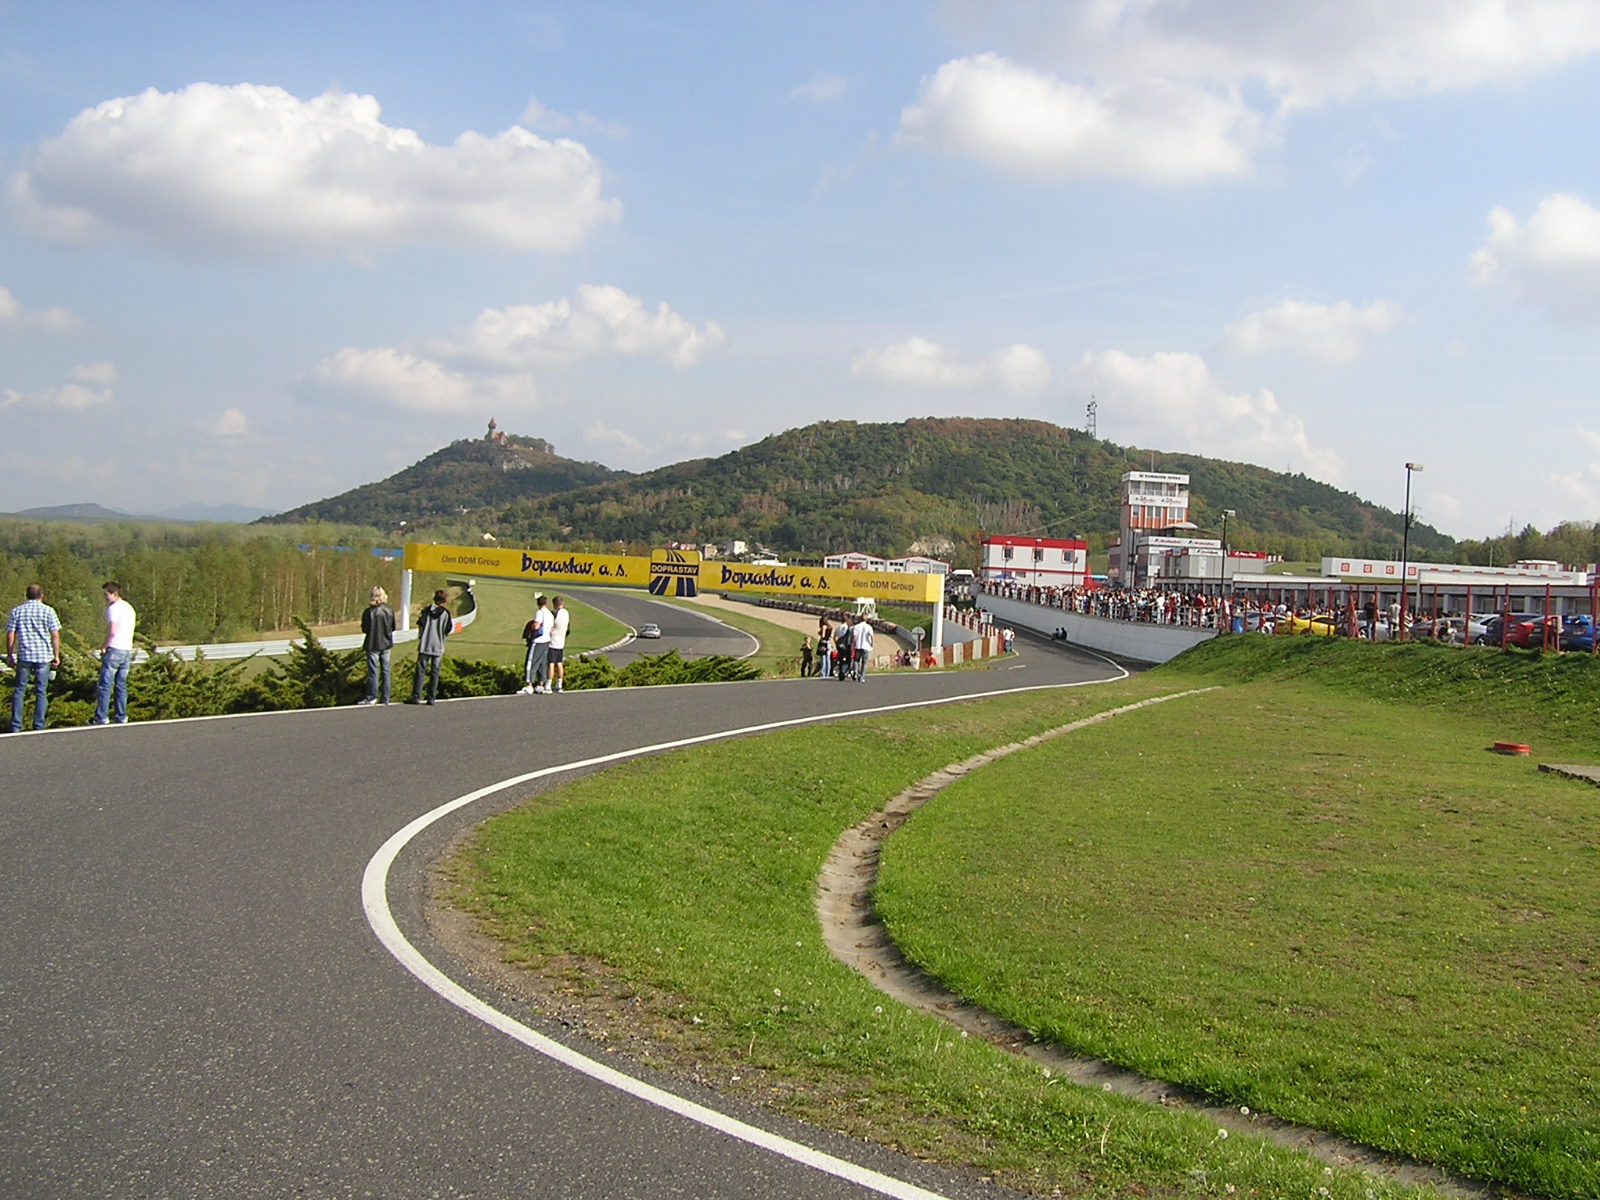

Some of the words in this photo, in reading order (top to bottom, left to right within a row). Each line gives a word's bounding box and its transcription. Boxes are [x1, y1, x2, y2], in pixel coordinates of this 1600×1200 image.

[458, 556, 476, 564] DDM
[478, 557, 500, 567] Group
[651, 564, 698, 574] DOPRASTAV
[870, 580, 889, 589] DDM
[891, 582, 914, 591] Group
